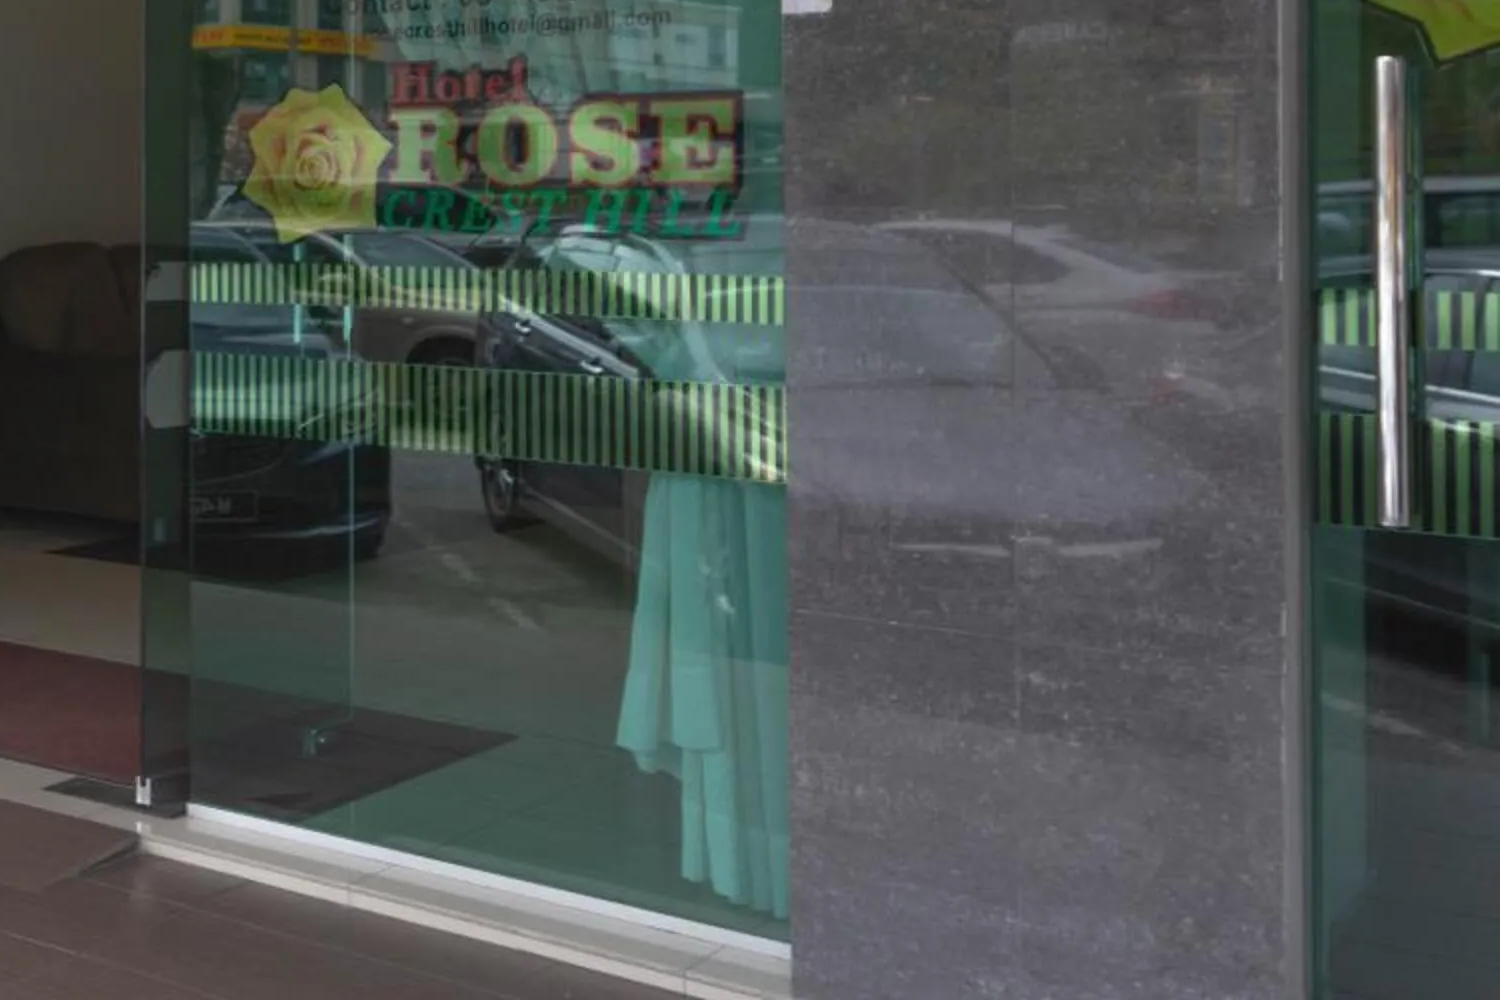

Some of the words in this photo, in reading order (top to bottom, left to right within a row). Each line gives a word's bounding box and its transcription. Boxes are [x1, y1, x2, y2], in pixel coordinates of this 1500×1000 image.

[394, 55, 527, 101] Hotel
[388, 98, 737, 186] ROSE
[384, 189, 570, 233] CREST
[579, 189, 744, 237] HILL
